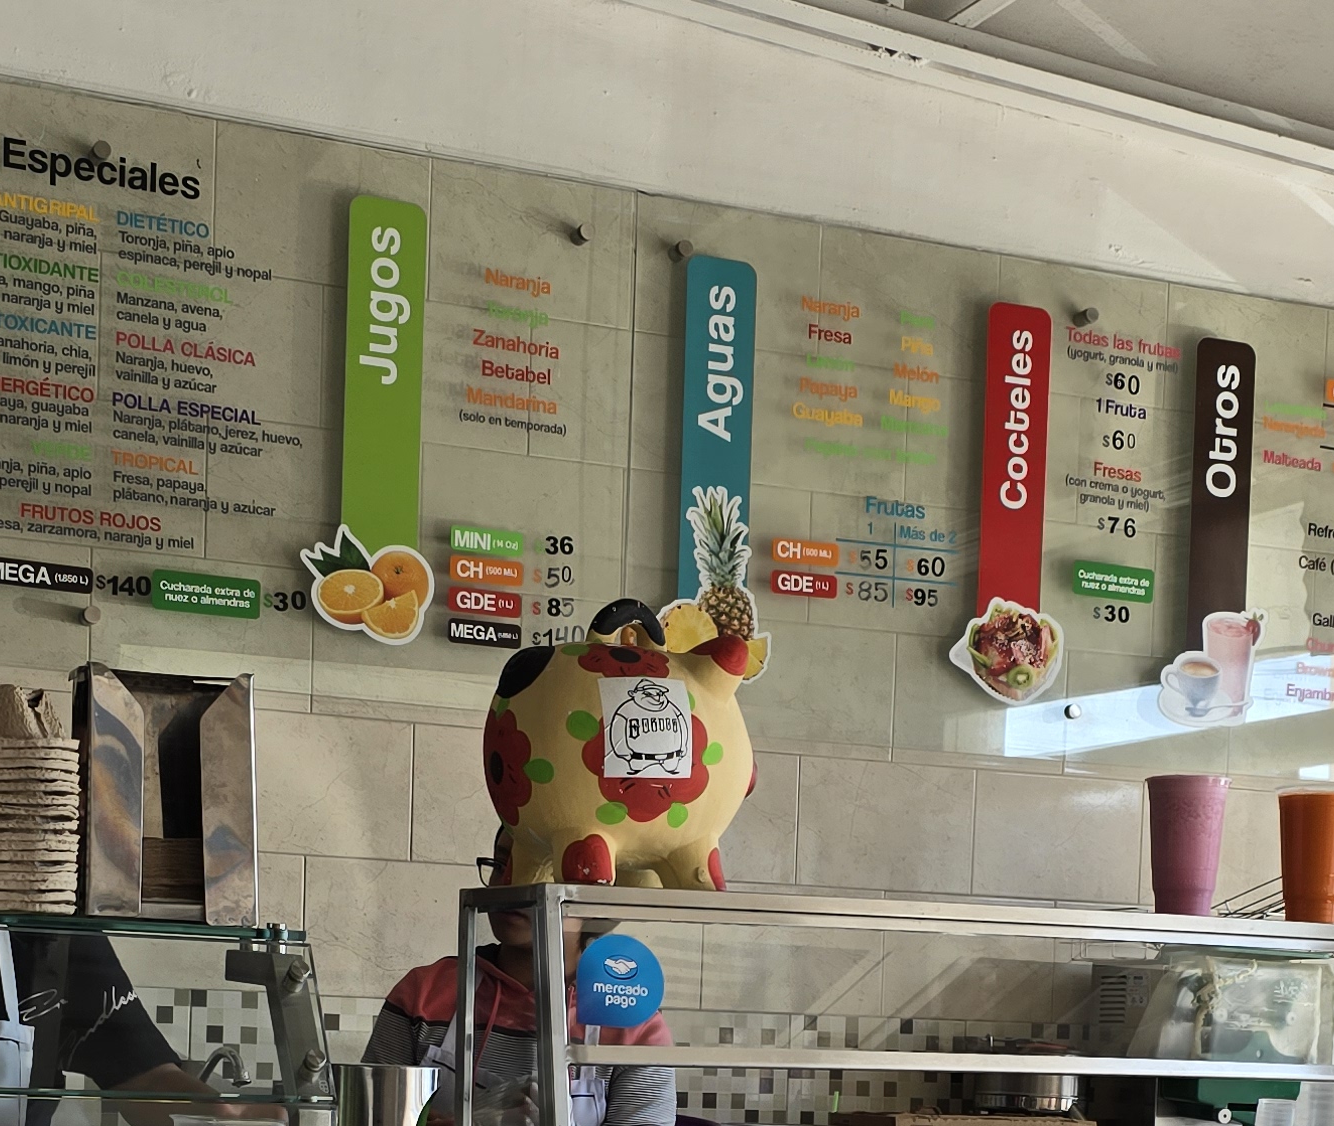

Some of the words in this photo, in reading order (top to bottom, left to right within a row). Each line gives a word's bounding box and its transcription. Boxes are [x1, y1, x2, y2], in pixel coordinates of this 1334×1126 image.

[2, 136, 201, 199] Especiales
[65, 219, 98, 239] piña,
[116, 209, 210, 239] DIETÉTICO
[3, 226, 56, 249] naranja
[118, 230, 170, 253] Toronja,
[118, 246, 181, 271] espinaca,
[183, 254, 223, 275] perejil
[236, 263, 272, 282] nopal
[12, 275, 63, 299] mango,
[484, 267, 551, 297] Naranja
[115, 291, 178, 314] Manzana,
[181, 302, 224, 321] avena,
[359, 225, 411, 385] Jugos
[801, 295, 861, 321] Naranja
[472, 328, 560, 360] Zanahoria
[808, 323, 852, 345] Fresa
[1066, 326, 1109, 348] Todas
[1113, 334, 1133, 351] las
[1138, 338, 1181, 360] frutas
[115, 331, 175, 354] POLLA
[180, 340, 256, 367] CLÁSICA
[1109, 353, 1145, 369] granola
[115, 352, 167, 375] Naranja,
[170, 359, 213, 379] huevo,
[481, 358, 551, 385] Betabel
[697, 285, 744, 443] Aguas
[893, 361, 940, 385] Melón
[115, 367, 160, 386] vainilla
[174, 375, 217, 394] azúcar
[799, 376, 858, 402] Papaya
[31, 398, 90, 421] guayaba
[112, 391, 172, 415] POLLA
[176, 400, 262, 426] ESPECIAL
[466, 385, 558, 415] Mandarina
[1106, 399, 1147, 420] Fruta
[458, 409, 486, 424] (solo
[489, 415, 502, 426] en
[504, 416, 567, 437] temporada)
[791, 401, 864, 427] Guayaba
[1000, 330, 1034, 510] Cocteles
[112, 427, 160, 446] canela,
[169, 416, 223, 437] plátano,
[222, 424, 259, 443] jerez,
[1205, 364, 1241, 498] Otros
[111, 449, 199, 476] TROPICAL
[1093, 461, 1142, 483] Fresas
[1263, 450, 1322, 472] Malteada
[1065, 473, 1087, 488] (con
[1089, 479, 1119, 493] crema
[20, 502, 95, 526] FRUTOS
[99, 509, 162, 533] ROJOS
[864, 496, 926, 520] Frutas
[27, 521, 101, 542] zarzamora,
[454, 529, 492, 551] MINI
[899, 525, 928, 541] Más
[776, 540, 801, 559] CH
[456, 559, 484, 579] CH
[1298, 555, 1327, 573] Café
[96, 572, 152, 597] $140
[159, 580, 213, 595] Cucharada
[214, 586, 239, 598] extra
[777, 574, 814, 593] GDE
[200, 595, 251, 609] almendras
[455, 590, 496, 611] GDE
[450, 622, 498, 642] MEGA
[593, 982, 648, 997] mercado
[605, 994, 637, 1009] pago
